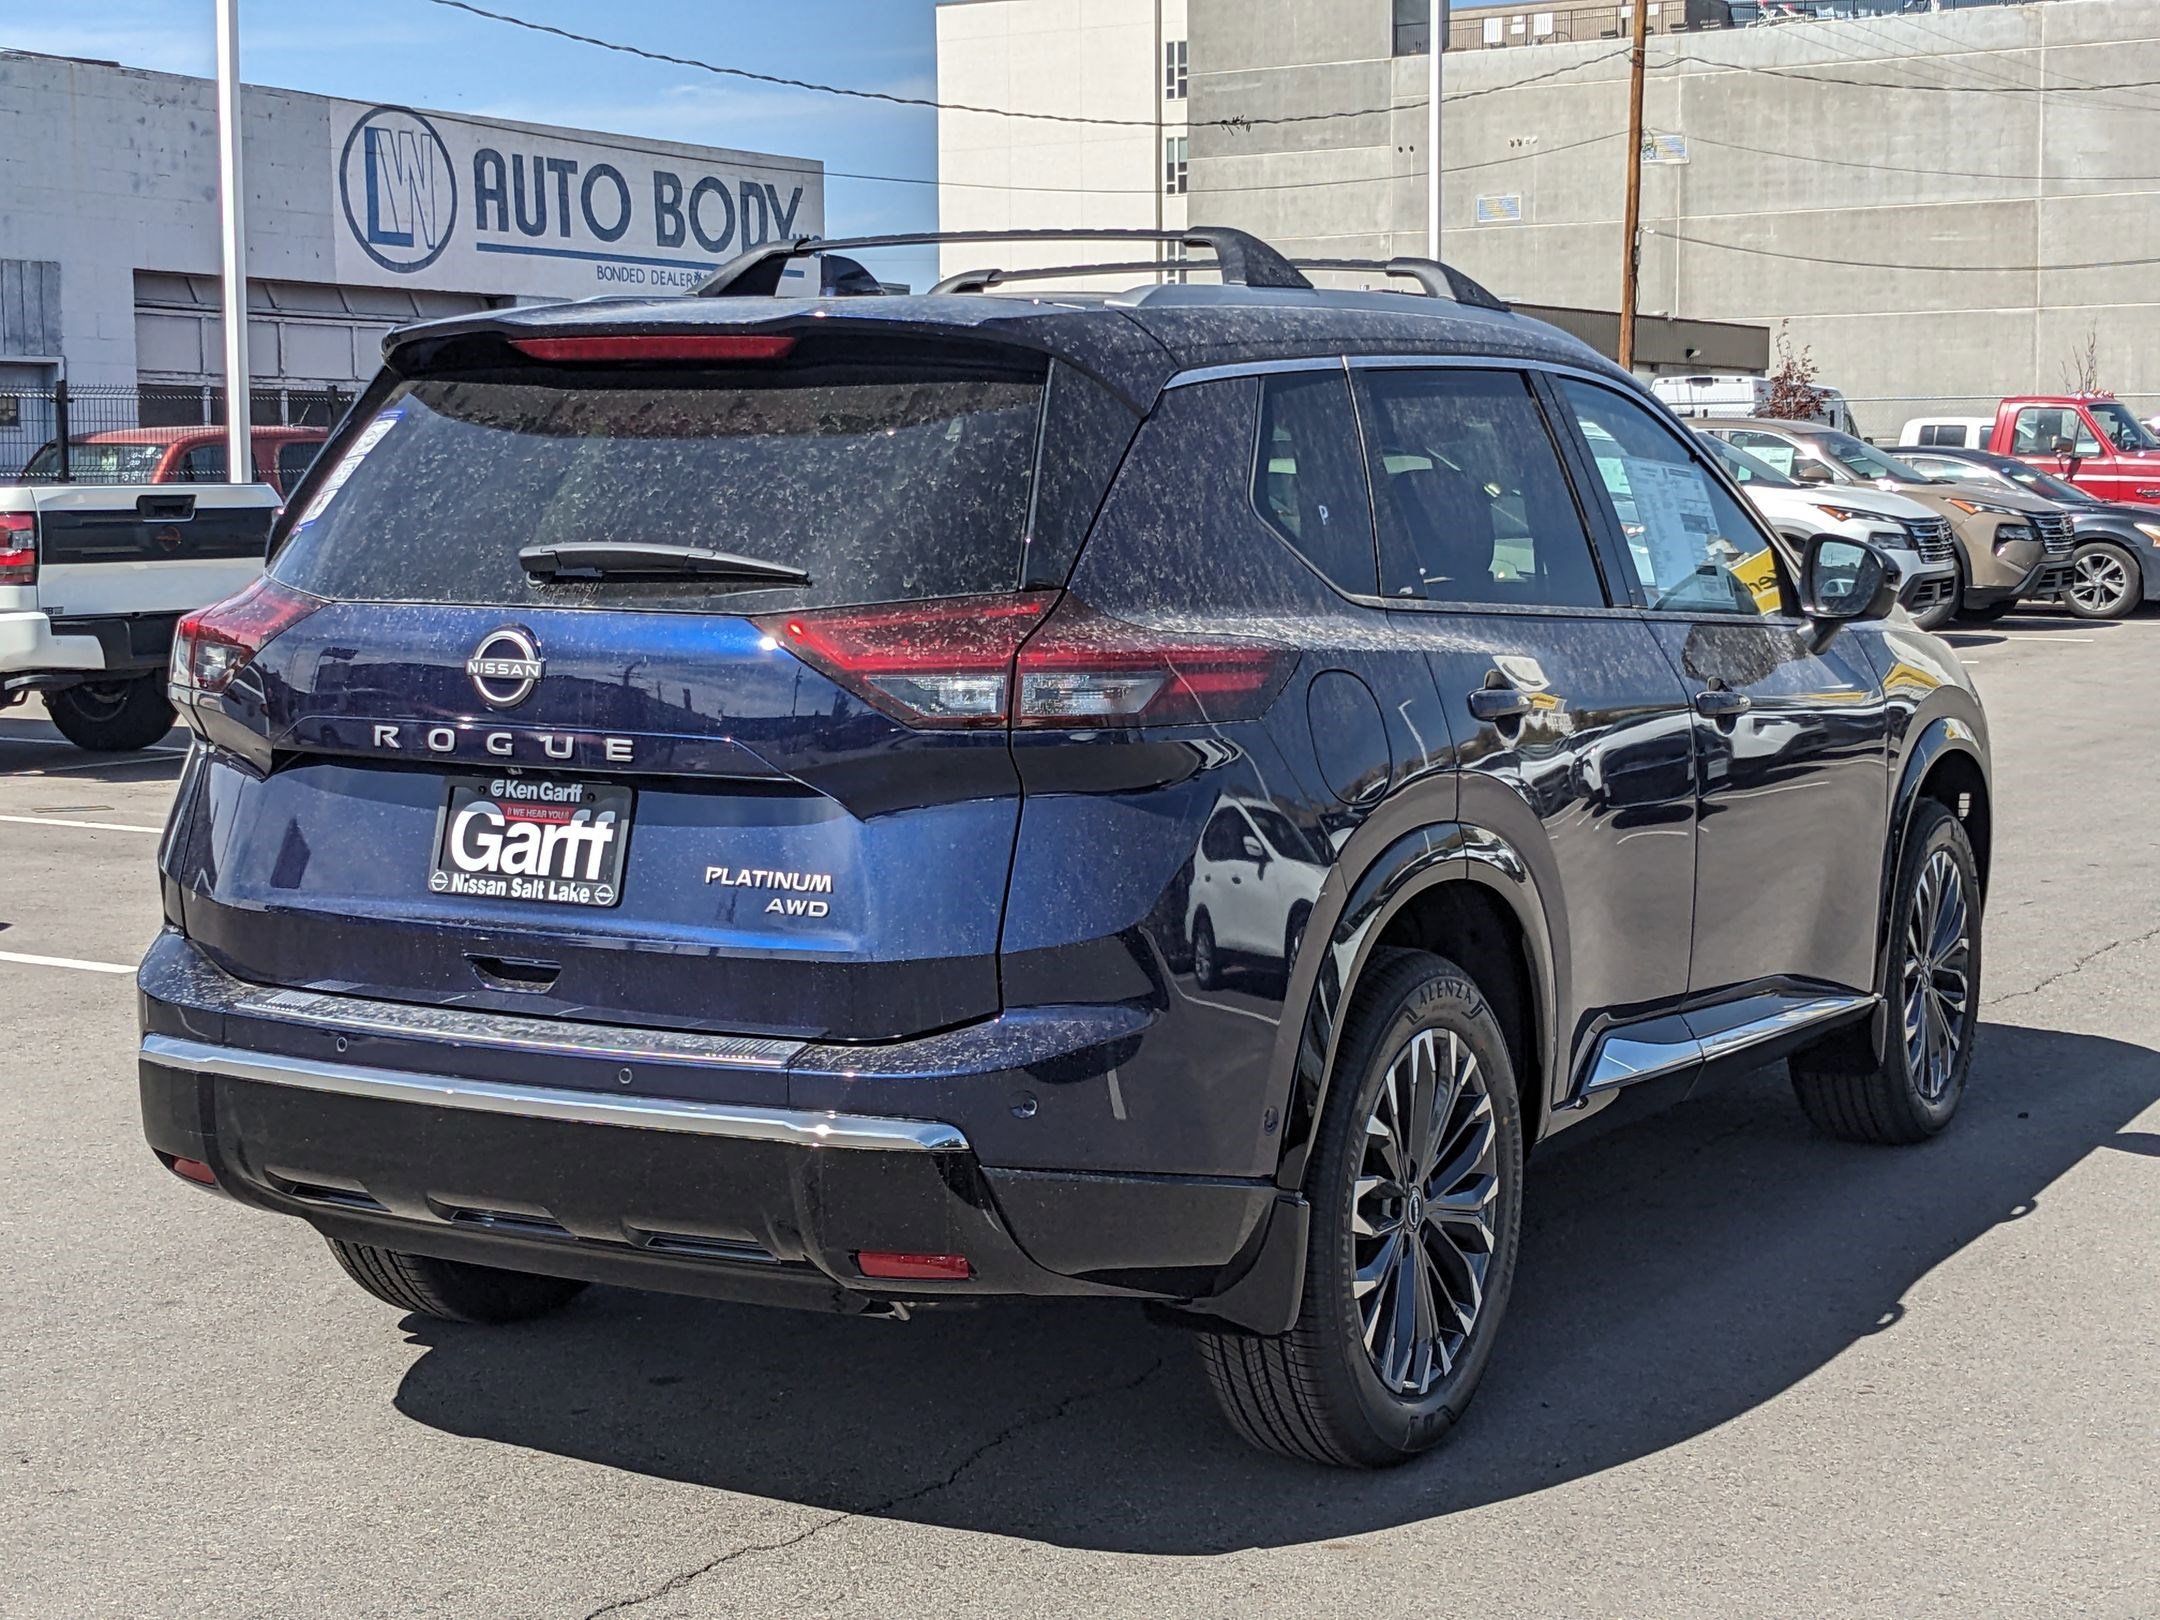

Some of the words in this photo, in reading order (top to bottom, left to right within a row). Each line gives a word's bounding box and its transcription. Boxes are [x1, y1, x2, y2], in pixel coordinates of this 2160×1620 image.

[473, 148, 632, 243] AUTO
[653, 170, 804, 254] BODY
[596, 264, 646, 283] BONDED
[467, 660, 541, 678] NISSAN
[373, 724, 635, 763] ROGUE
[503, 780, 537, 800] Ken
[539, 781, 583, 803] Garff
[513, 807, 525, 817] WE
[526, 809, 547, 818] HEAR
[451, 800, 616, 881] Garff
[451, 873, 507, 897] Nissan
[511, 878, 545, 900] Salt
[549, 881, 591, 904] Lake
[704, 866, 833, 893] PLATINUM
[764, 898, 829, 918] AWD
[1419, 980, 1472, 1006] ALENZA
